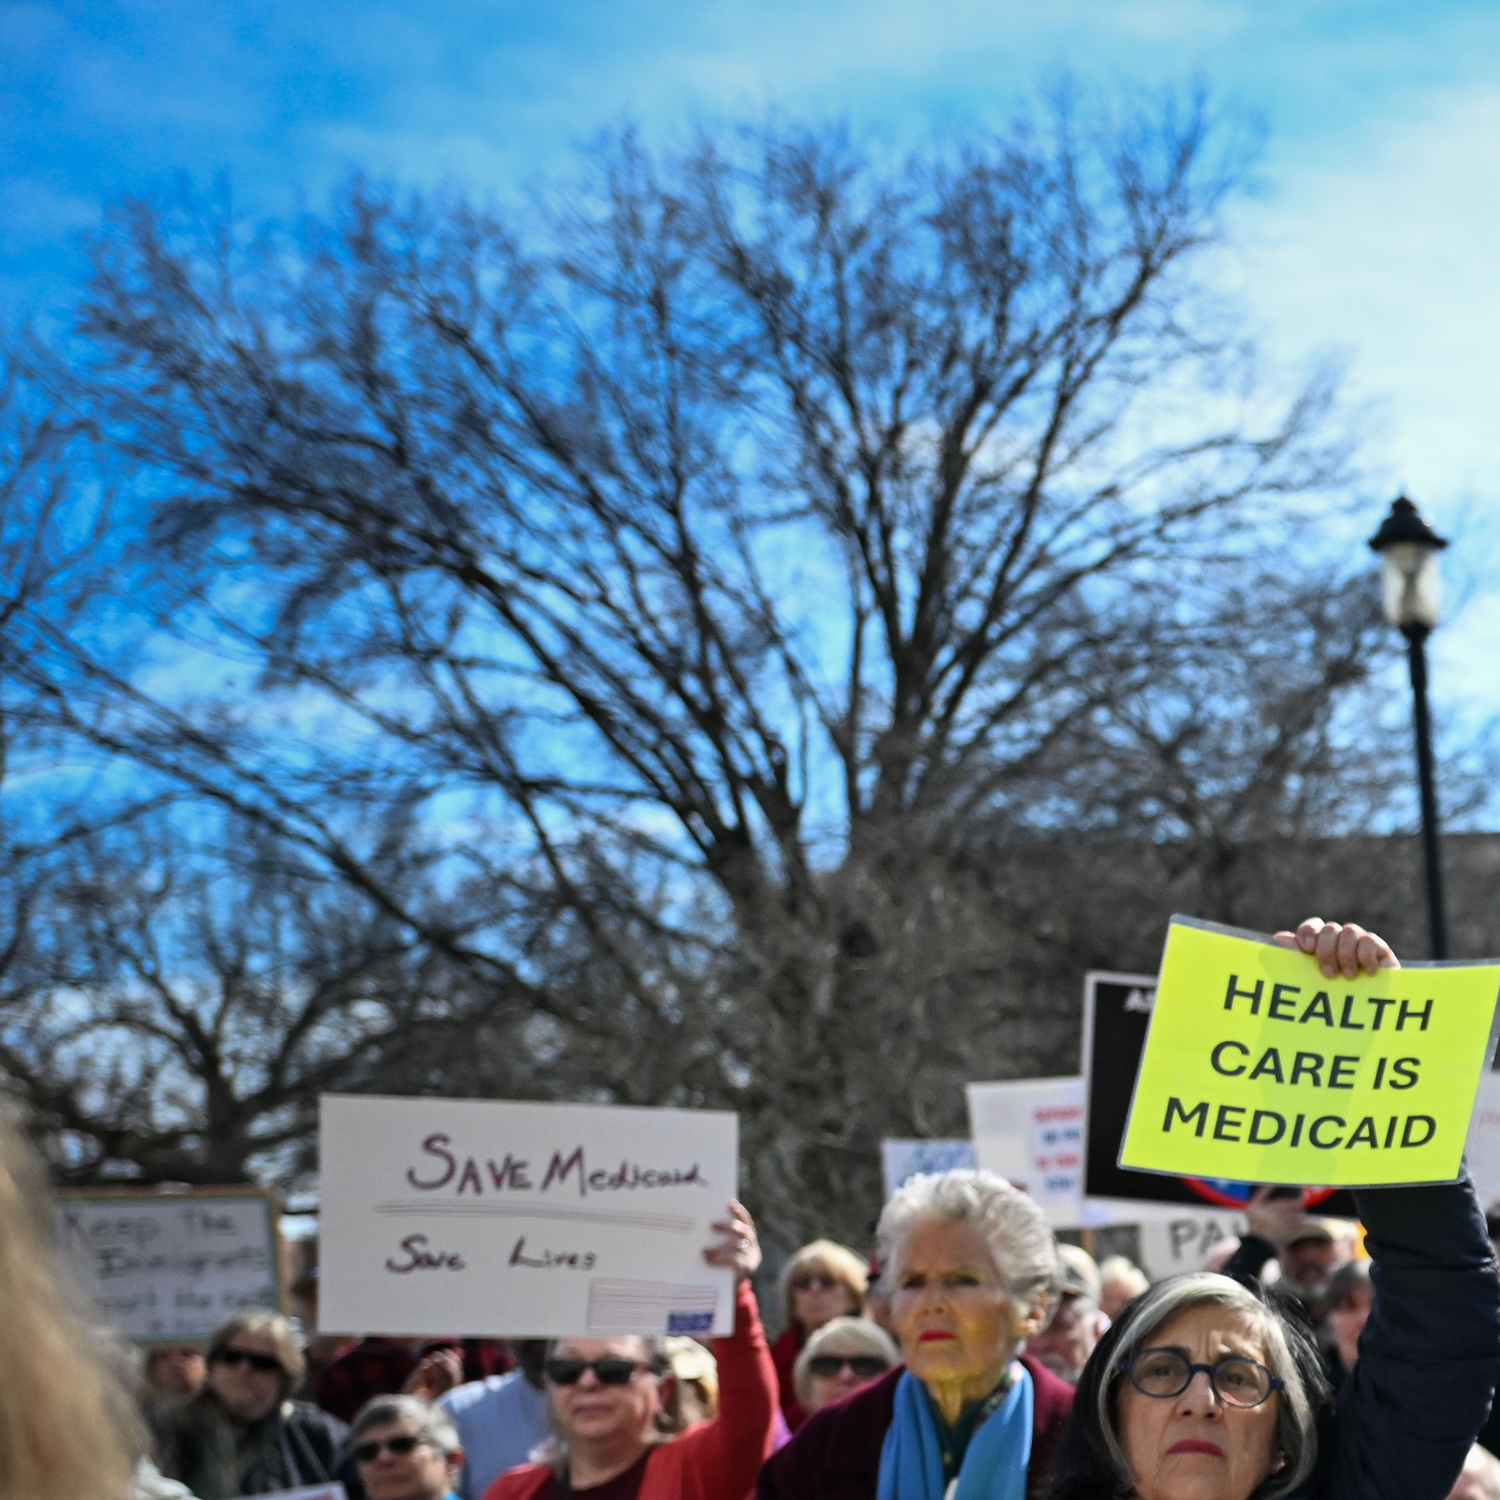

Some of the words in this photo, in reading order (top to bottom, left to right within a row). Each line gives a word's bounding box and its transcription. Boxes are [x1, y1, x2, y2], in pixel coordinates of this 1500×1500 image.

[1224, 974, 1434, 1031] HEALTH
[1211, 1041, 1360, 1089] CARE
[1373, 1057, 1421, 1090] IS
[1162, 1097, 1437, 1150] MEDICAID
[407, 1133, 533, 1197] SAVE
[541, 1144, 708, 1198] Medicaid
[385, 1233, 466, 1274] Save
[508, 1236, 597, 1270] Lives
